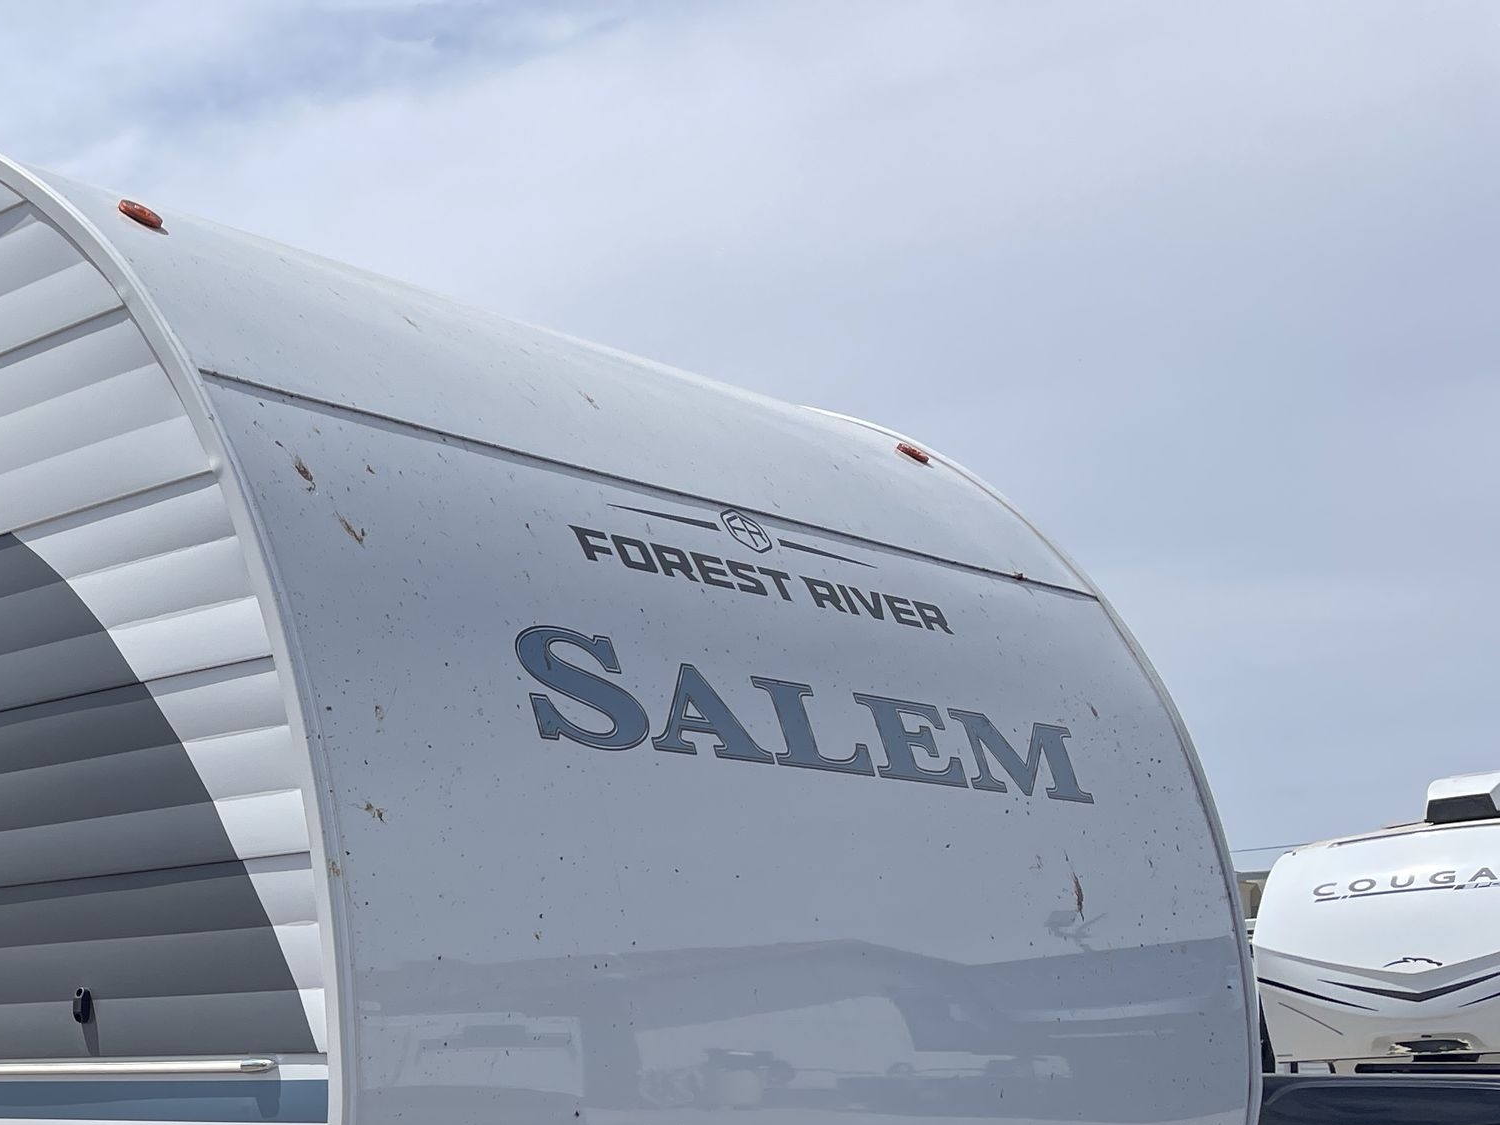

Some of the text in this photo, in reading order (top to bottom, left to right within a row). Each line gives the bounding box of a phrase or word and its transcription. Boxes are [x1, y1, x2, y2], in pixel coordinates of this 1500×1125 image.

[567, 524, 956, 635] FOREST RIVER
[514, 624, 1095, 804] SALEM
[1312, 867, 1498, 897] COUGA
